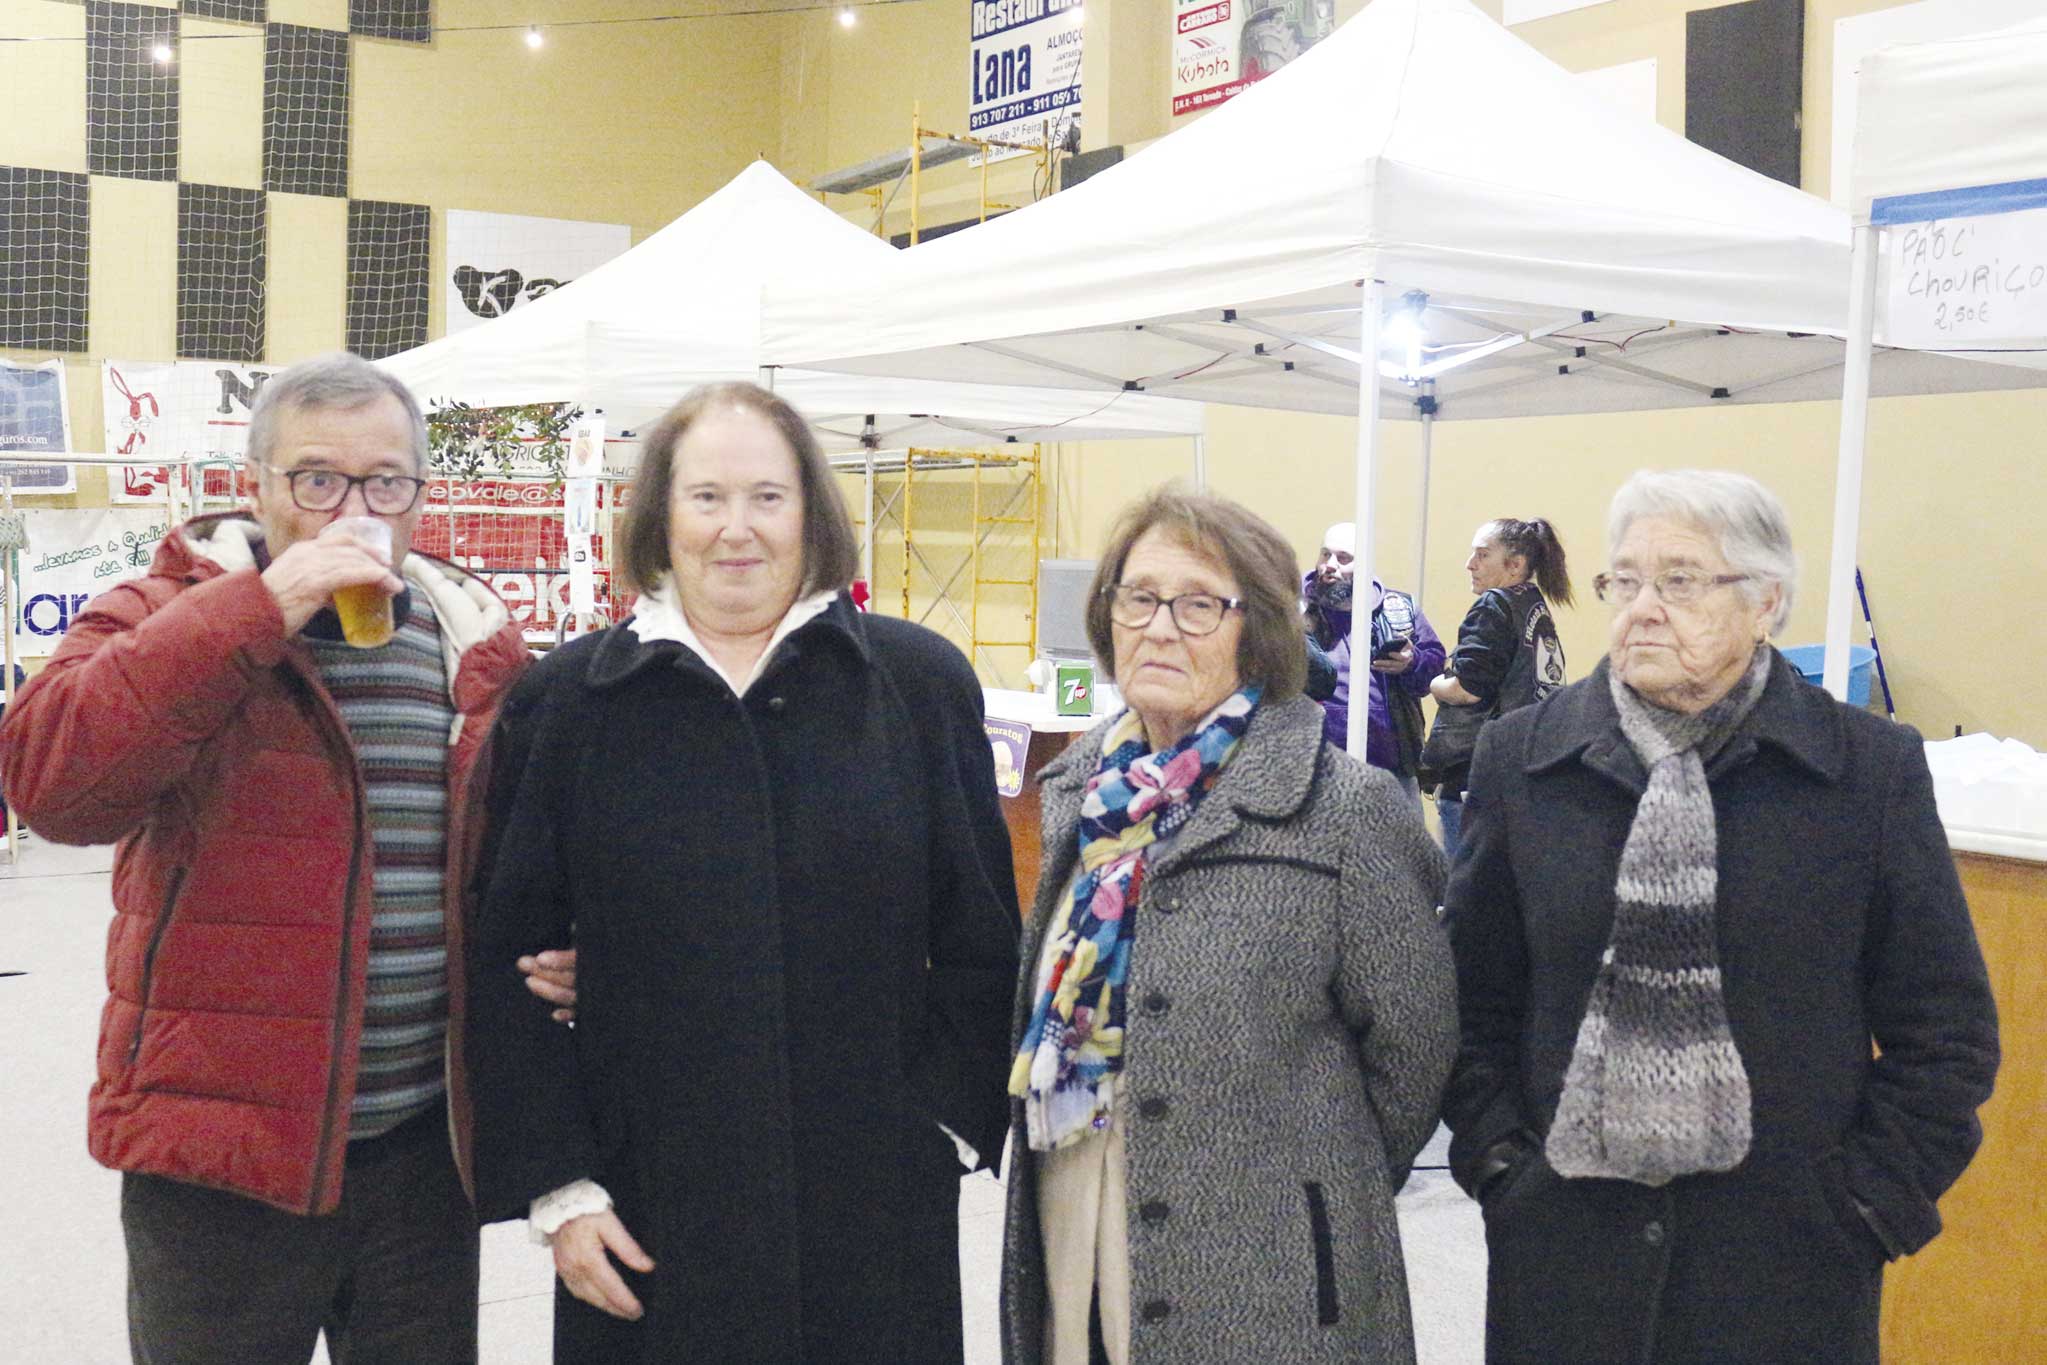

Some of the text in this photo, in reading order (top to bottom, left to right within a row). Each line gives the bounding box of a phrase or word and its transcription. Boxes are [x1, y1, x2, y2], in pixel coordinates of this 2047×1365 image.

[973, 43, 1031, 105] Lana
[971, 110, 988, 128] 913
[990, 108, 1006, 121] 707
[1008, 104, 1025, 117] 211
[1033, 95, 1050, 111] 911
